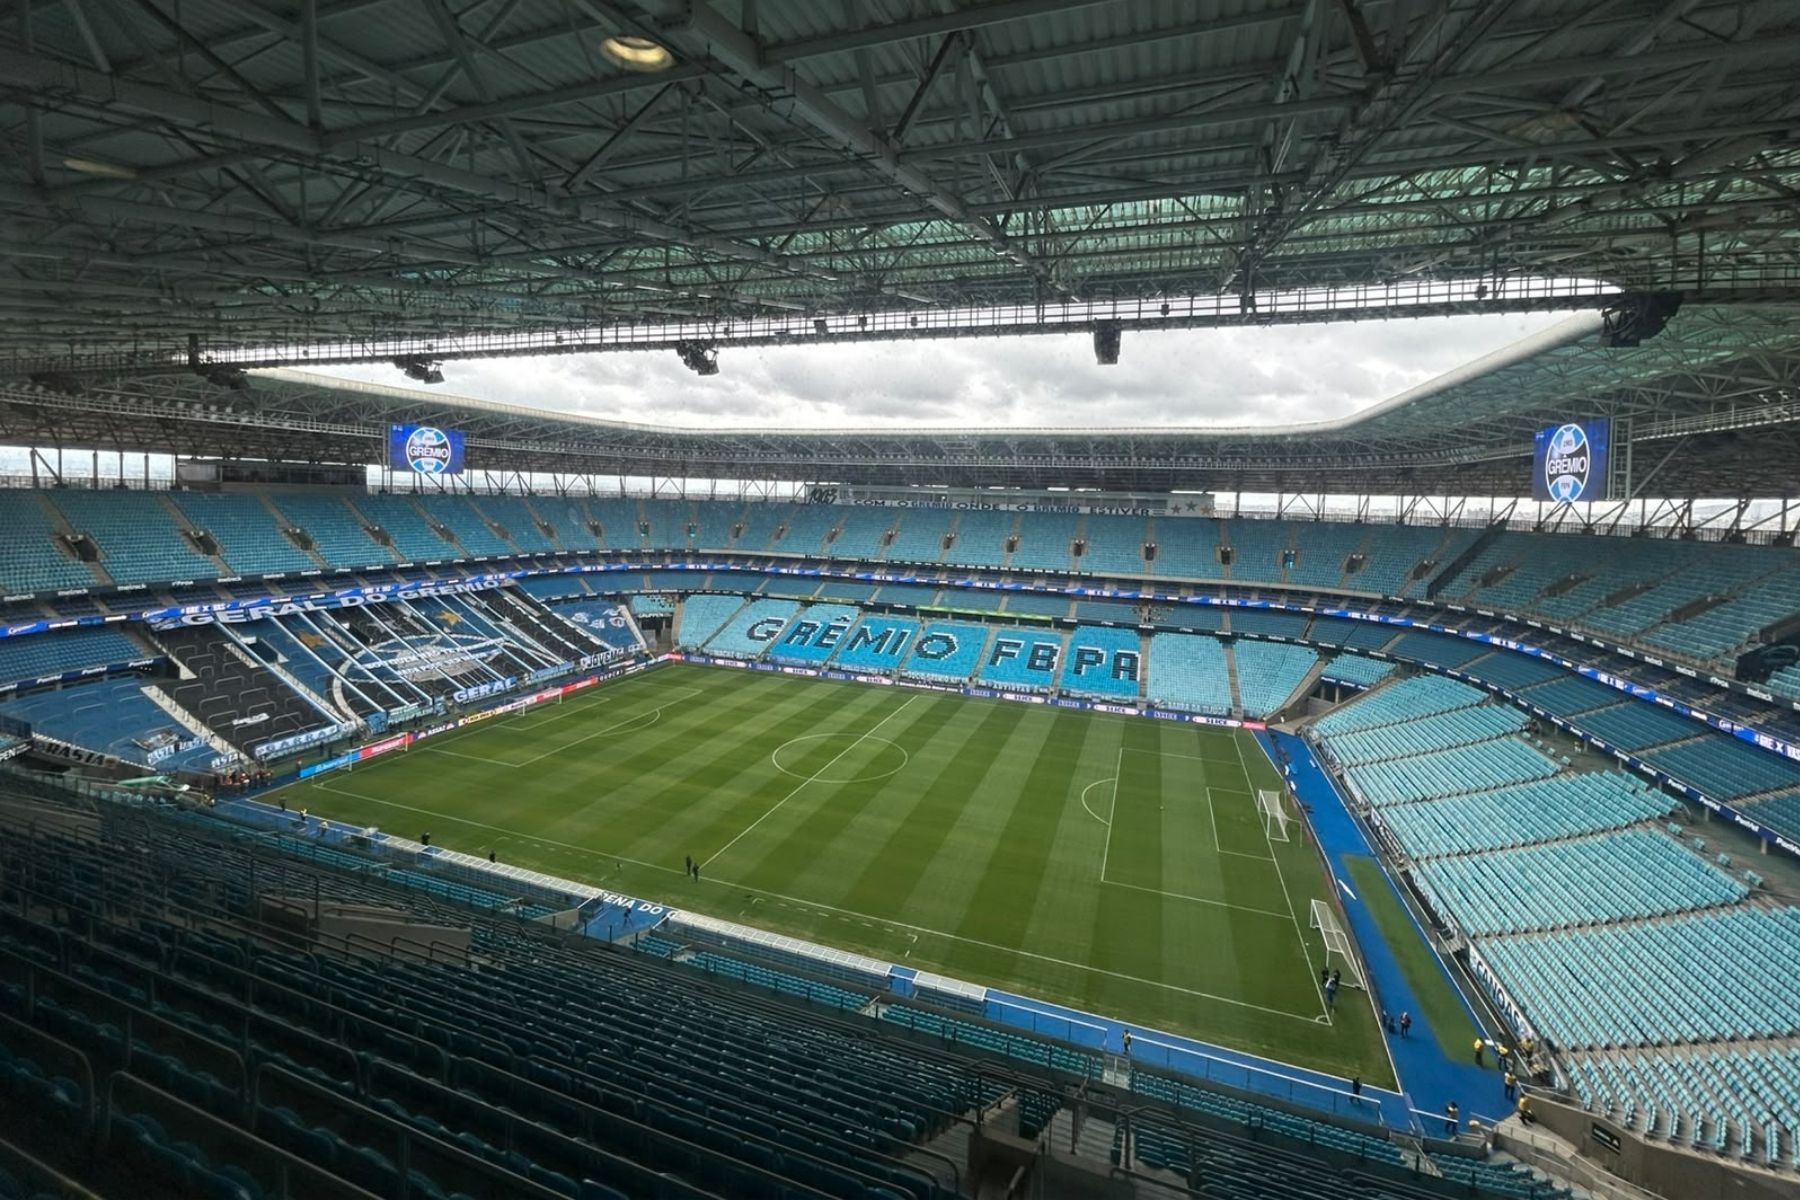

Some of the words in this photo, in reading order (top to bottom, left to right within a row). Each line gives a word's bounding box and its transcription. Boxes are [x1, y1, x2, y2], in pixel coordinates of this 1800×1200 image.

[1548, 454, 1587, 475] GRÊMIO
[808, 488, 838, 505] 1903
[956, 502, 1001, 511] ONDE
[1090, 506, 1150, 517] ESTIVER
[181, 600, 328, 626] GERAL
[340, 592, 388, 608] DO
[747, 614, 959, 660] GRÊMIO
[453, 676, 517, 703] GERAL
[46, 742, 105, 766] RASTA
[637, 902, 664, 915] DO
[1475, 960, 1521, 1031] CANOAS
